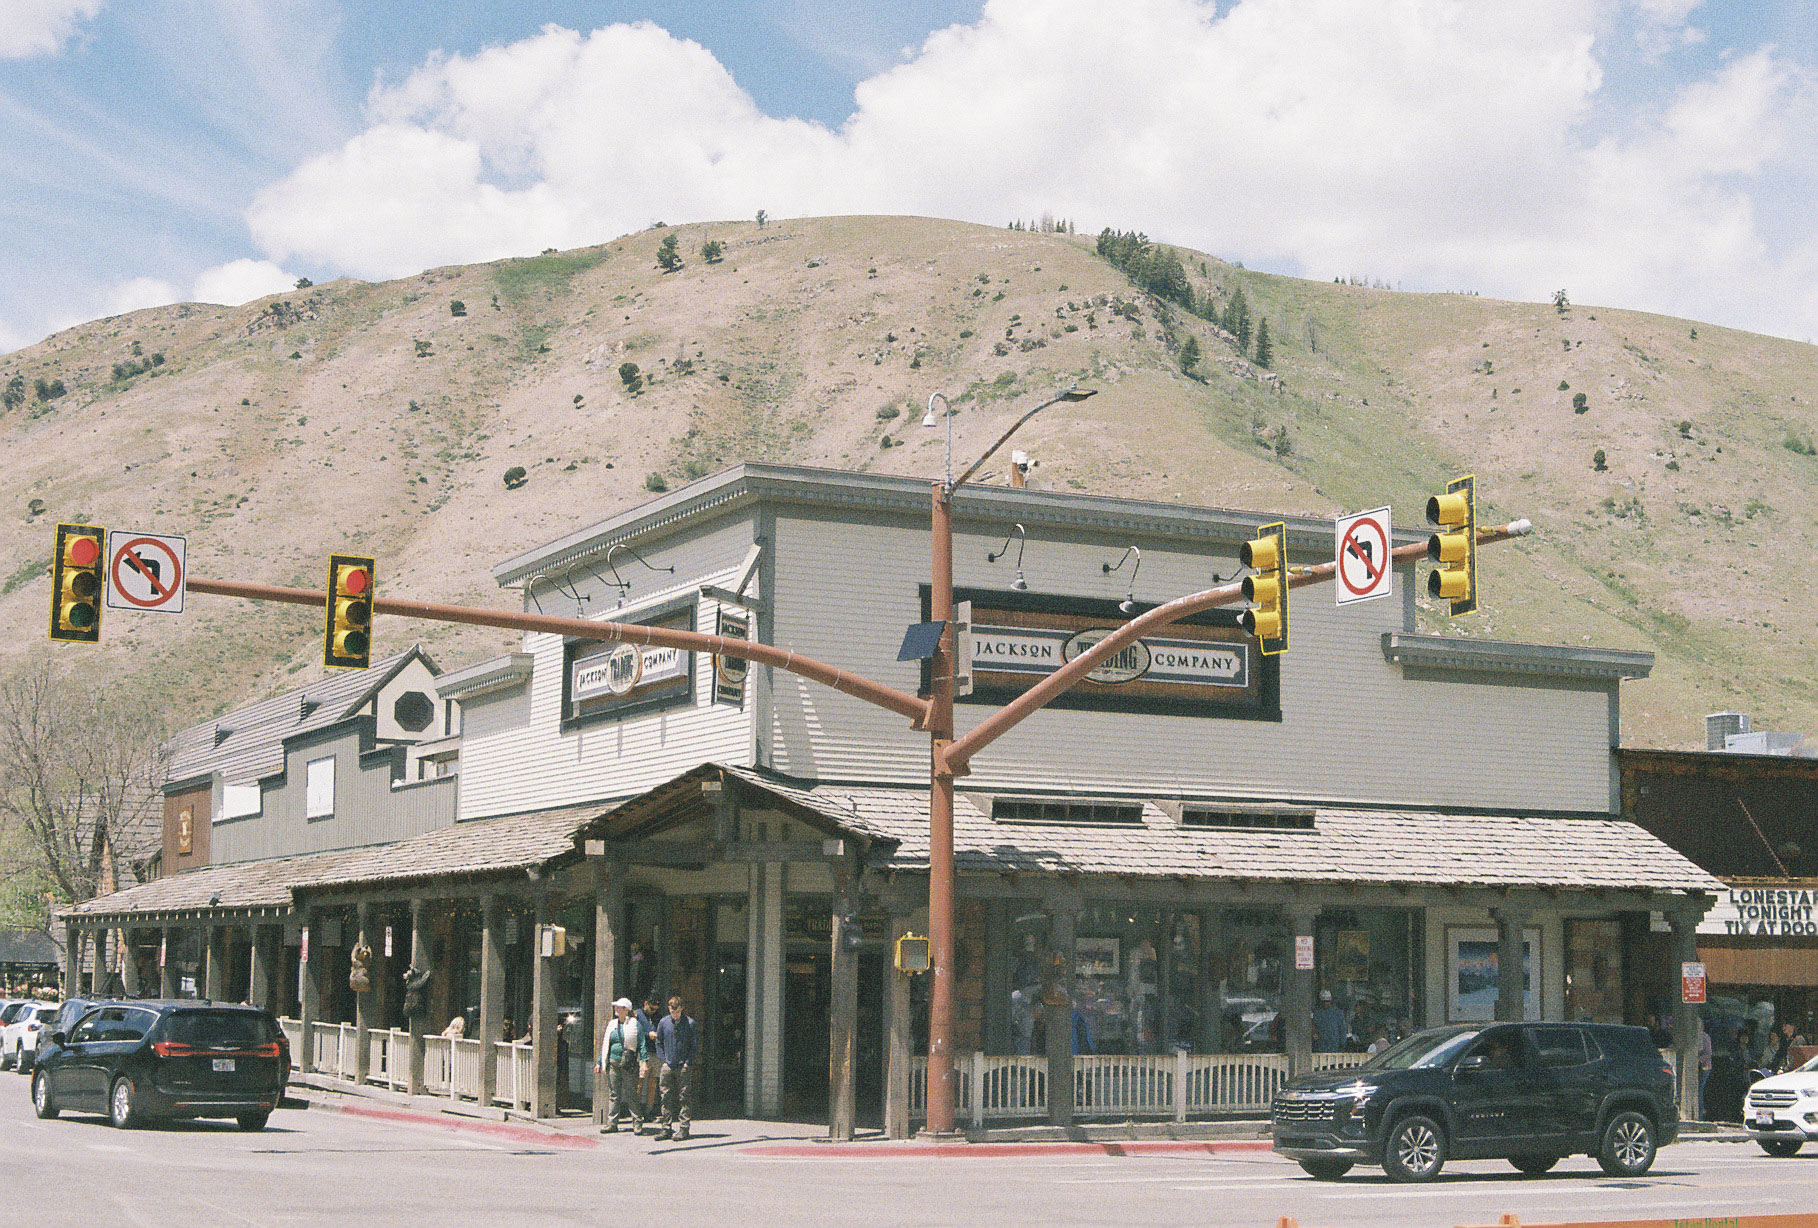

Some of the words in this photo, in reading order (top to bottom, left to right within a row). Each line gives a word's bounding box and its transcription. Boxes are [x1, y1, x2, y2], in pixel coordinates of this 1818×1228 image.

[644, 648, 677, 669] COMPANY
[976, 641, 1051, 658] JACKSON
[1155, 653, 1233, 670] COMPANY
[1737, 905, 1813, 921] TONIGHT
[1725, 920, 1751, 935] TIX
[1756, 920, 1777, 935] AT
